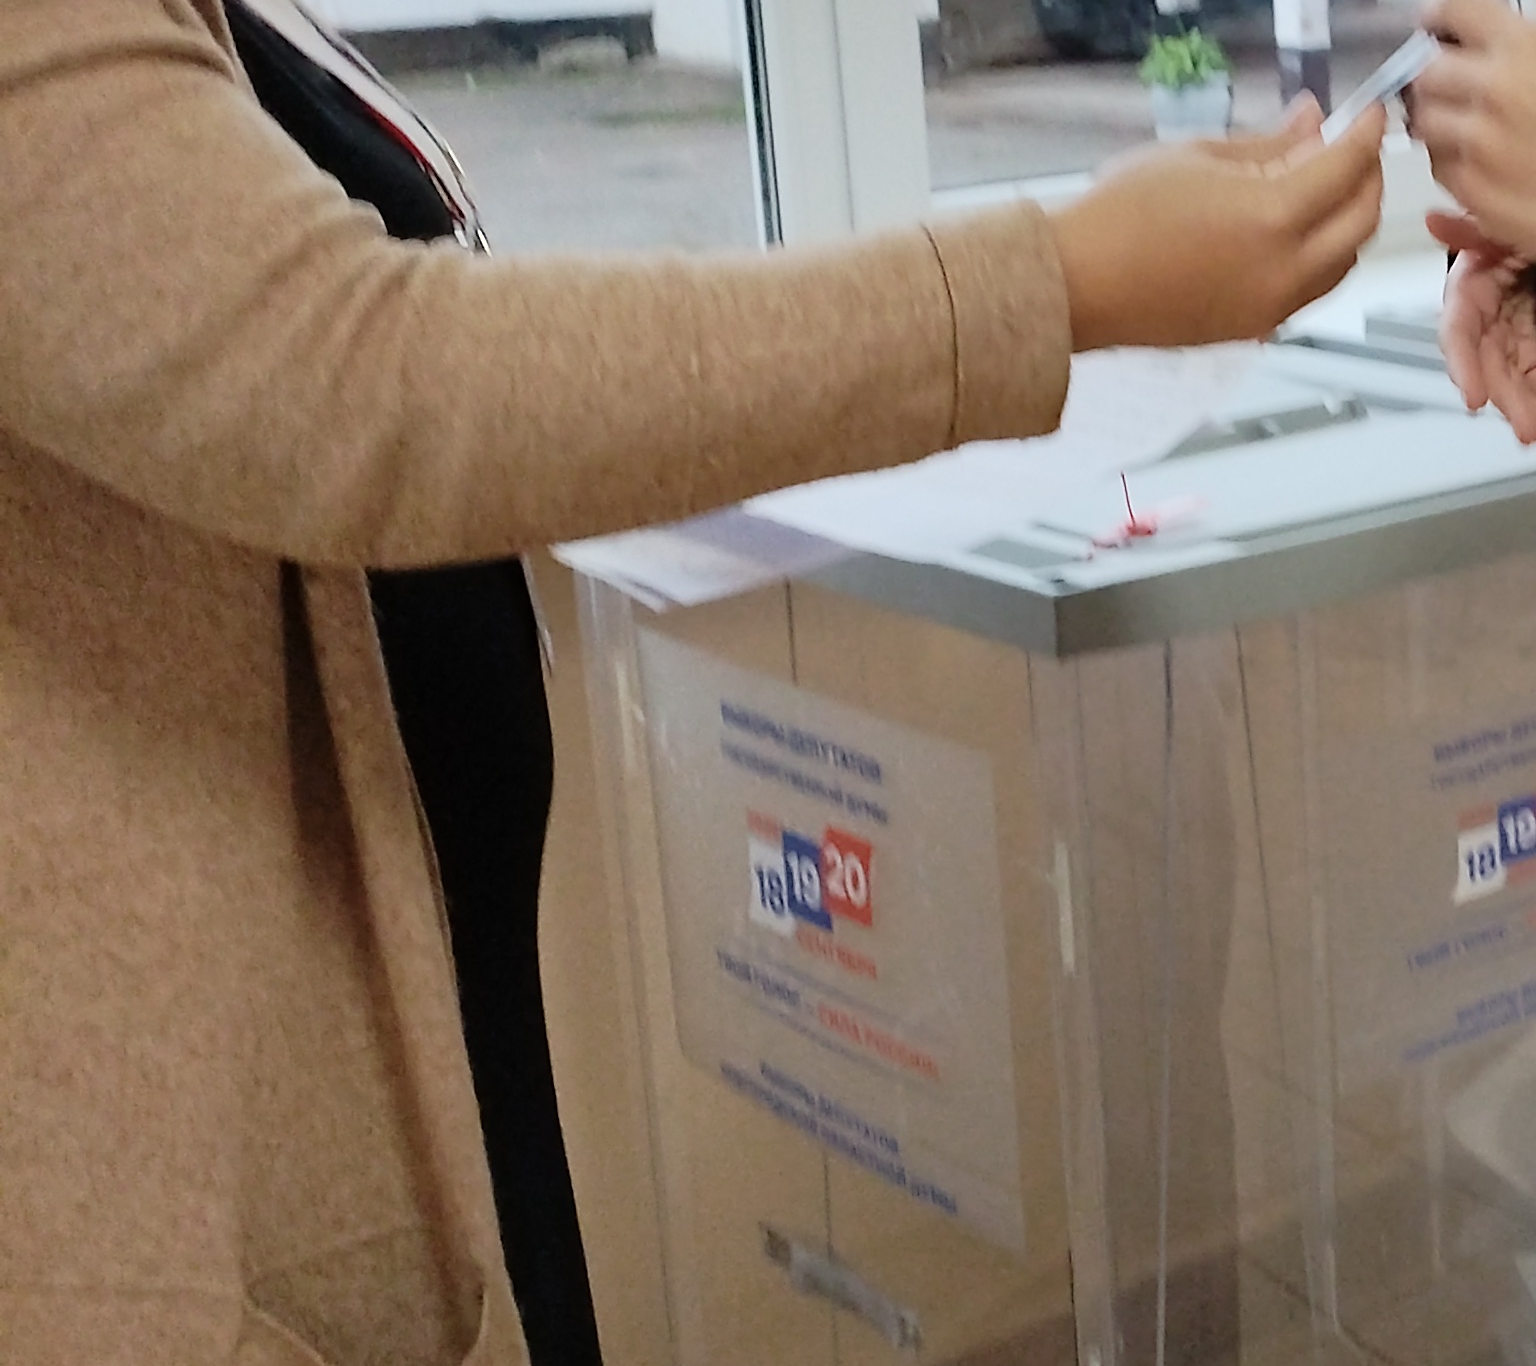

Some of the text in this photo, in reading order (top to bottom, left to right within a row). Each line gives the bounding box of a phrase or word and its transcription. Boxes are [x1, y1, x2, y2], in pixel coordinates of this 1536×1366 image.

[755, 842, 868, 917] 18 19 20
